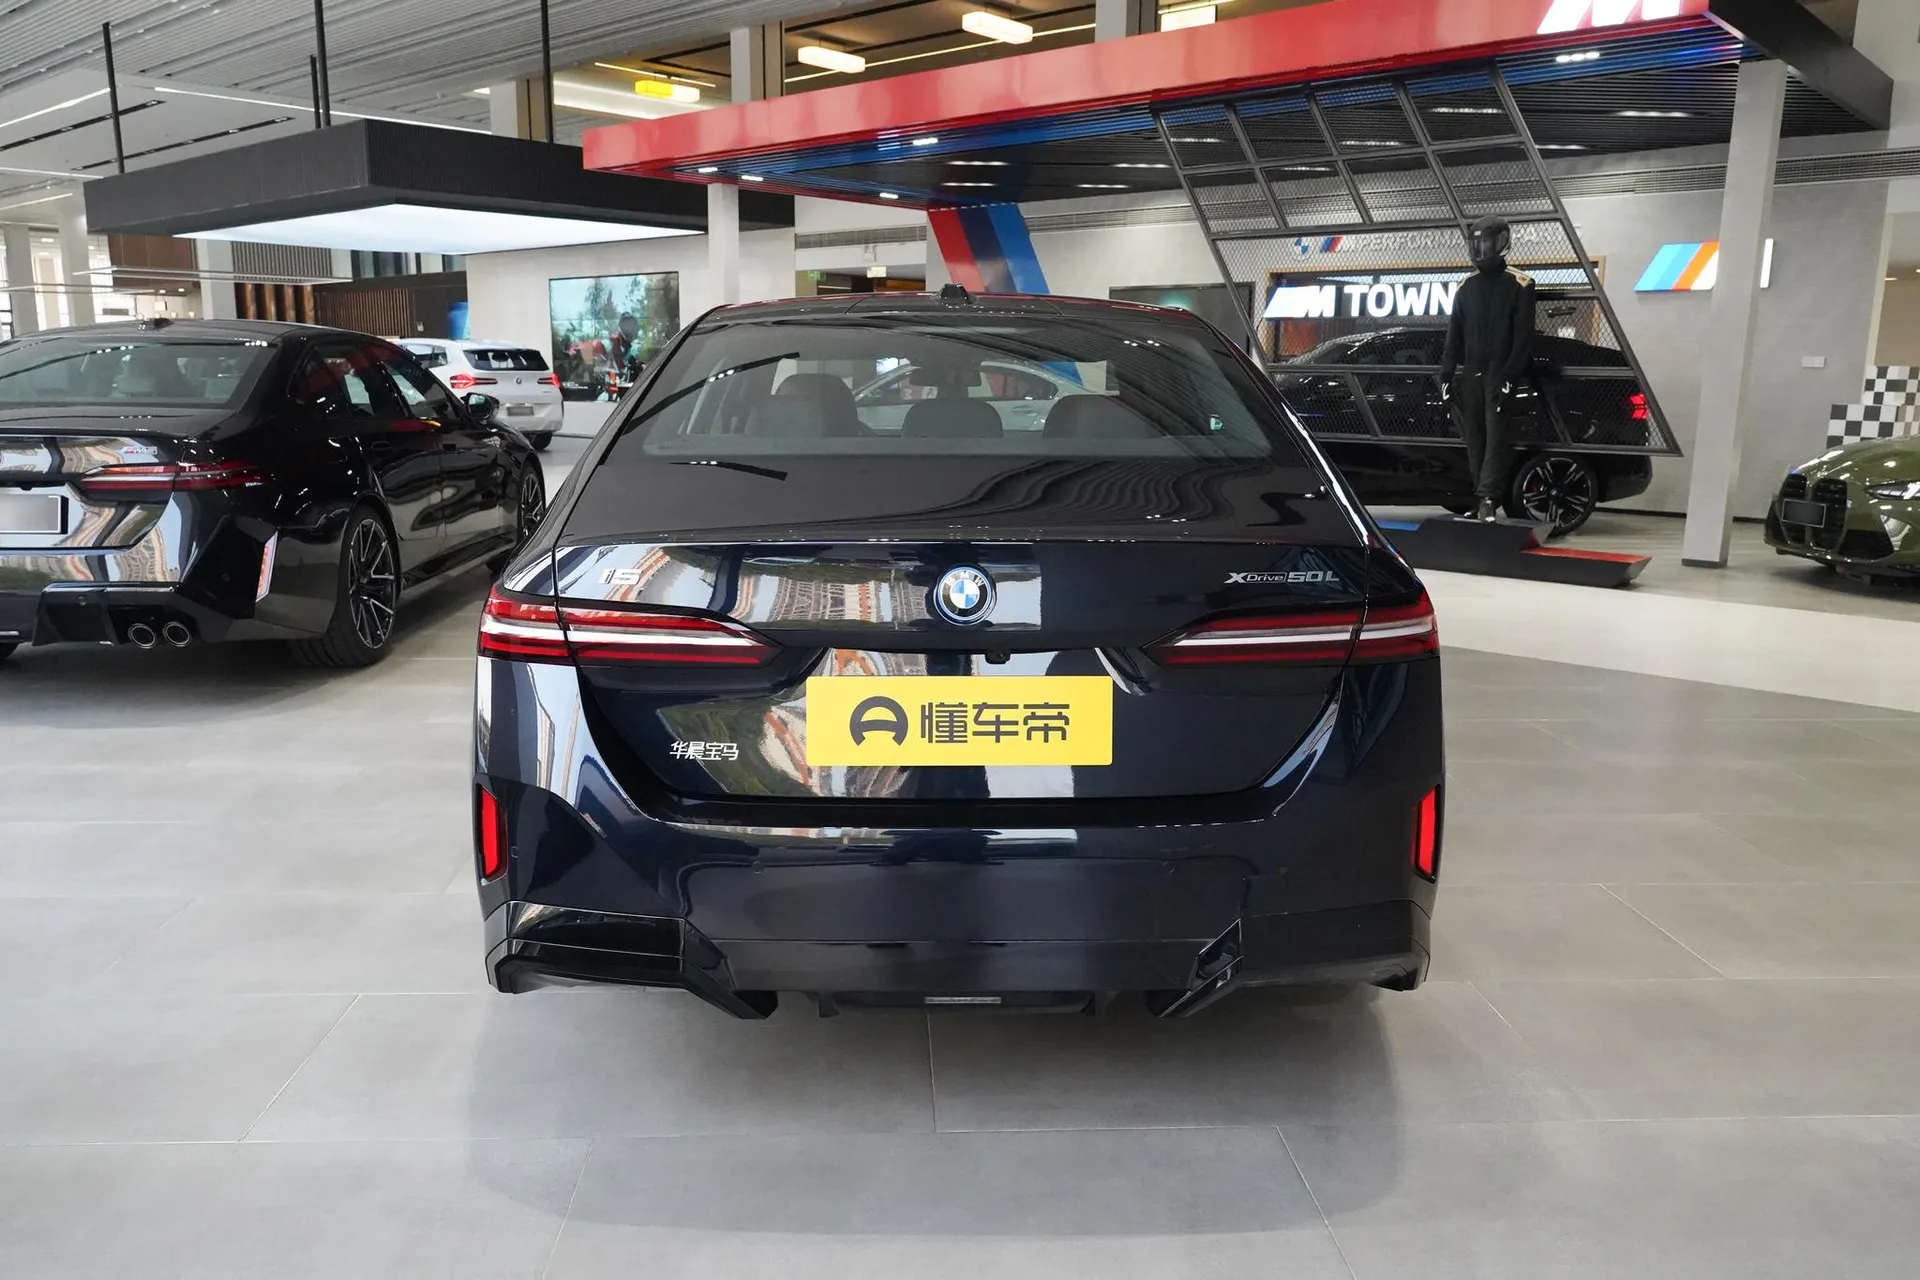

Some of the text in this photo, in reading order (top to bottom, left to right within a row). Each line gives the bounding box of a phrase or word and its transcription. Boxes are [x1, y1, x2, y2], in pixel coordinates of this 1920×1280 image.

[1343, 282, 1458, 317] TOWN
[920, 702, 1070, 744] 懂车帝
[668, 740, 739, 761] 华晨宝马
